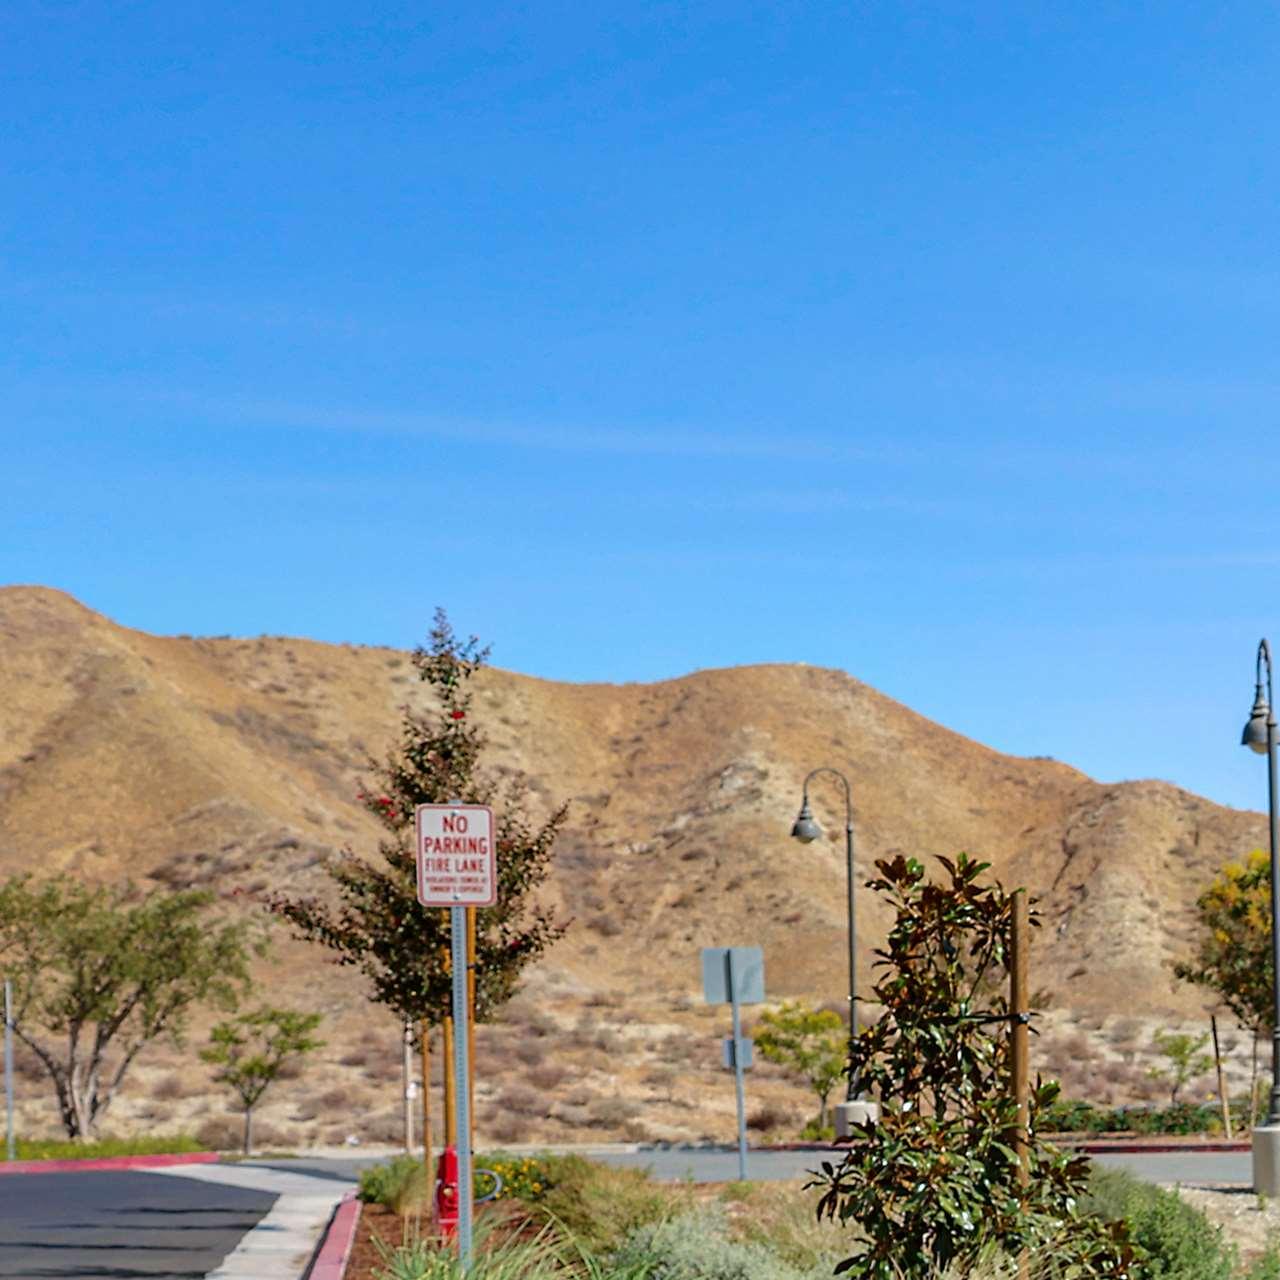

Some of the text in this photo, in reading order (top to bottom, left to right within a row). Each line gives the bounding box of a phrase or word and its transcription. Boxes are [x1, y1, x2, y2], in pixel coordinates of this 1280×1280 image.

[442, 816, 468, 833] NO
[424, 836, 487, 855] PARKING
[425, 858, 484, 873] FIRE LANE
